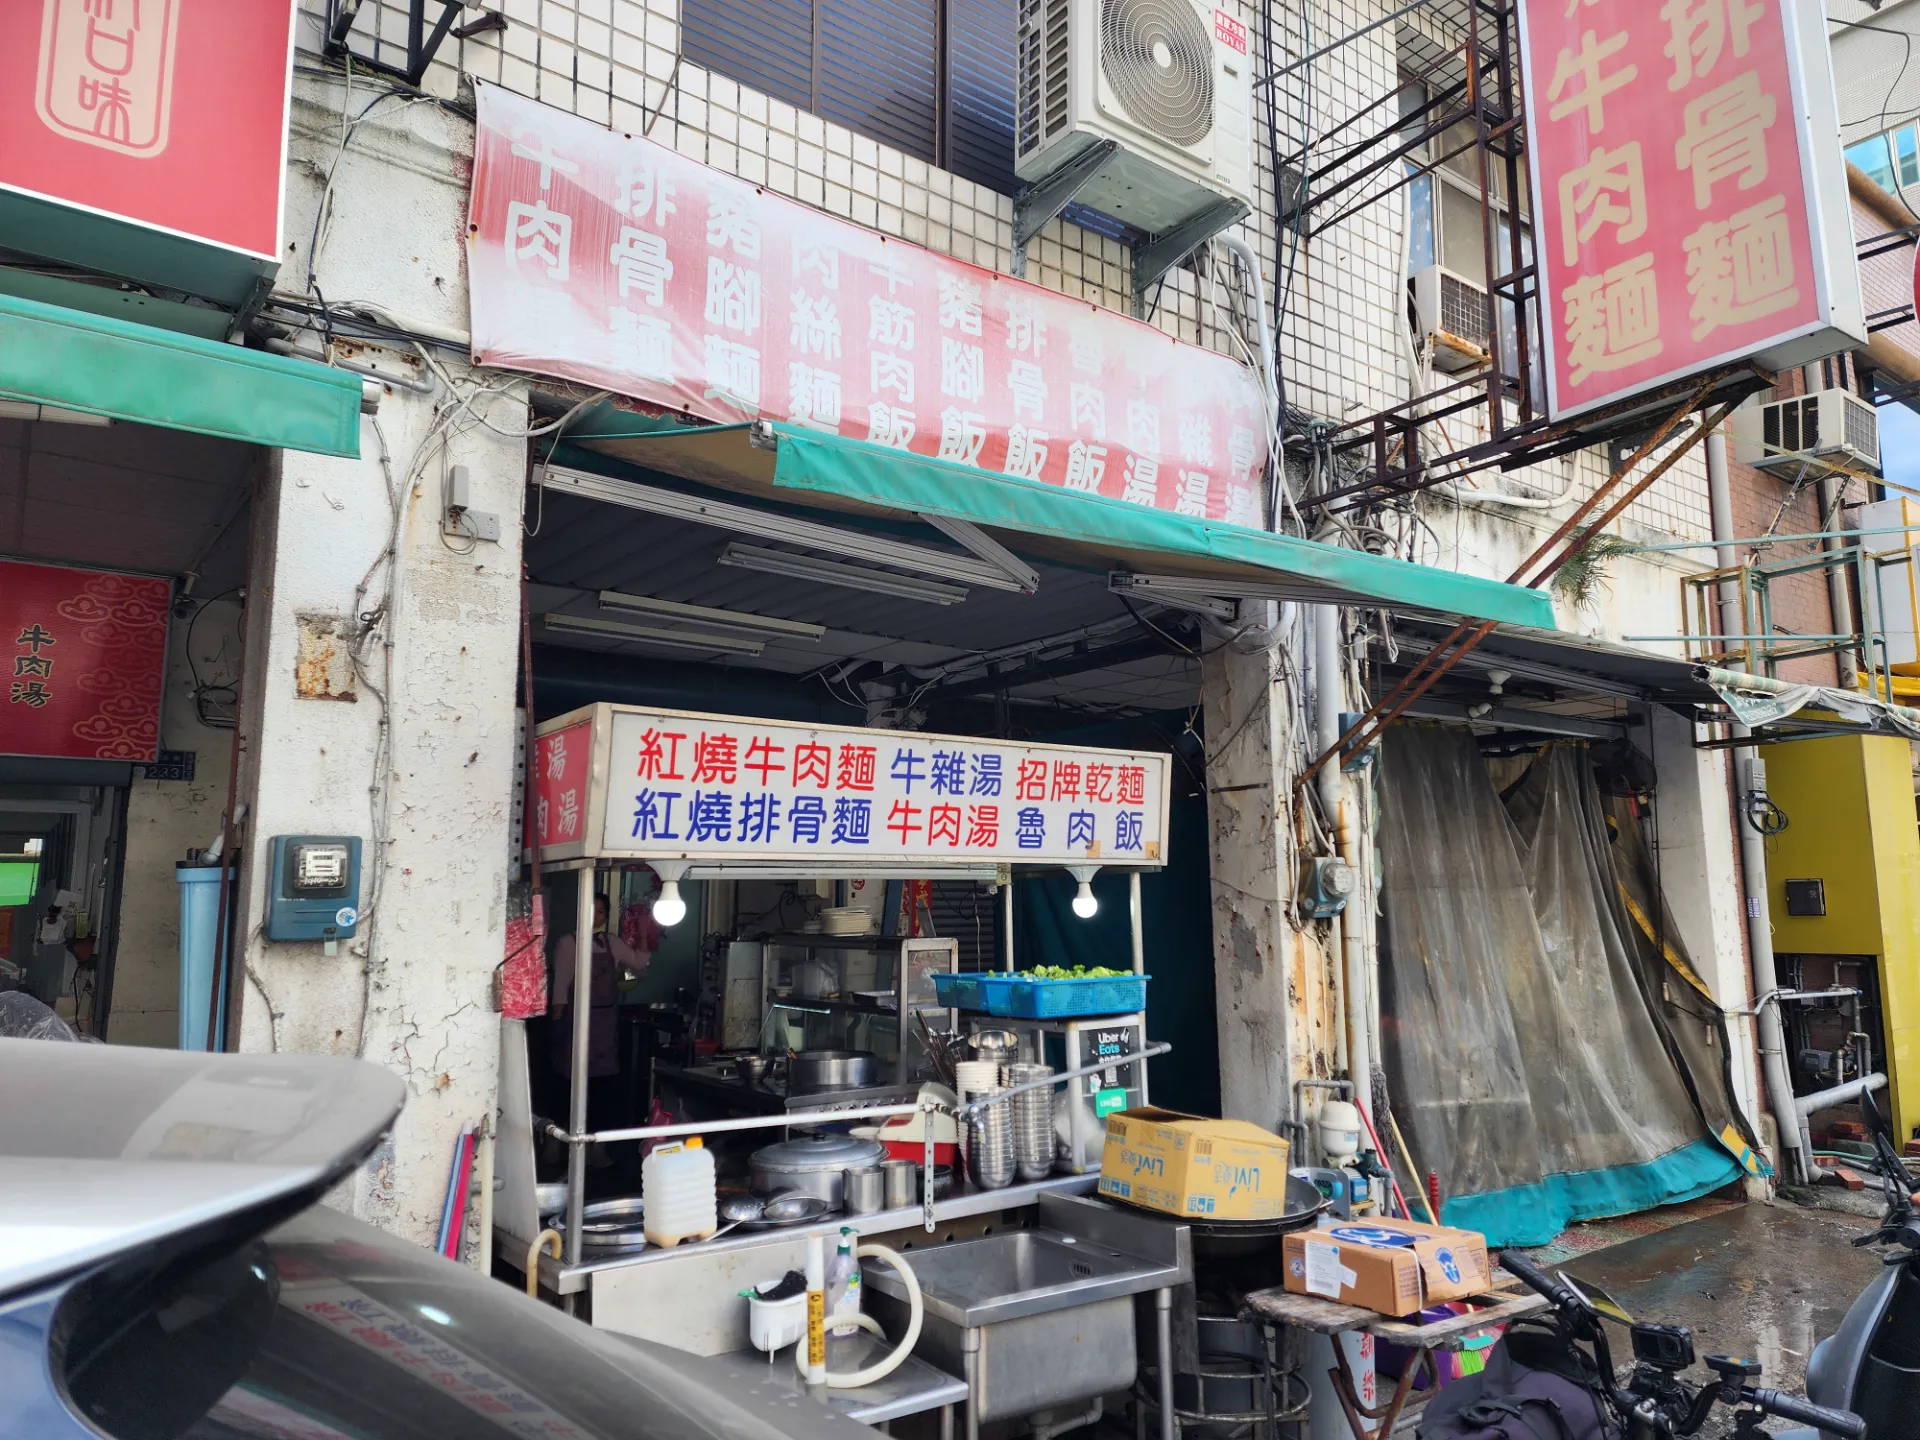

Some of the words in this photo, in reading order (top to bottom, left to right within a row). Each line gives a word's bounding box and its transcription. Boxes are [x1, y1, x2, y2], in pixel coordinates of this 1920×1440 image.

[1216, 28, 1246, 54] ROYAL
[1546, 0, 1663, 388] 牛肉麵
[1660, 0, 1801, 343] 排骨麵
[9, 623, 56, 708] 牛肉湯
[637, 727, 877, 792] 紅燒牛肉麵
[890, 748, 1002, 797] 牛雜湯
[1016, 758, 1145, 805] 招牌乾麵
[631, 787, 872, 844] 紅燒排骨麵
[887, 799, 999, 847] 牛肉湯
[1015, 807, 1143, 850] 魯肉飯
[1098, 1032, 1119, 1043] Uber
[1099, 1044, 1120, 1055] Eats
